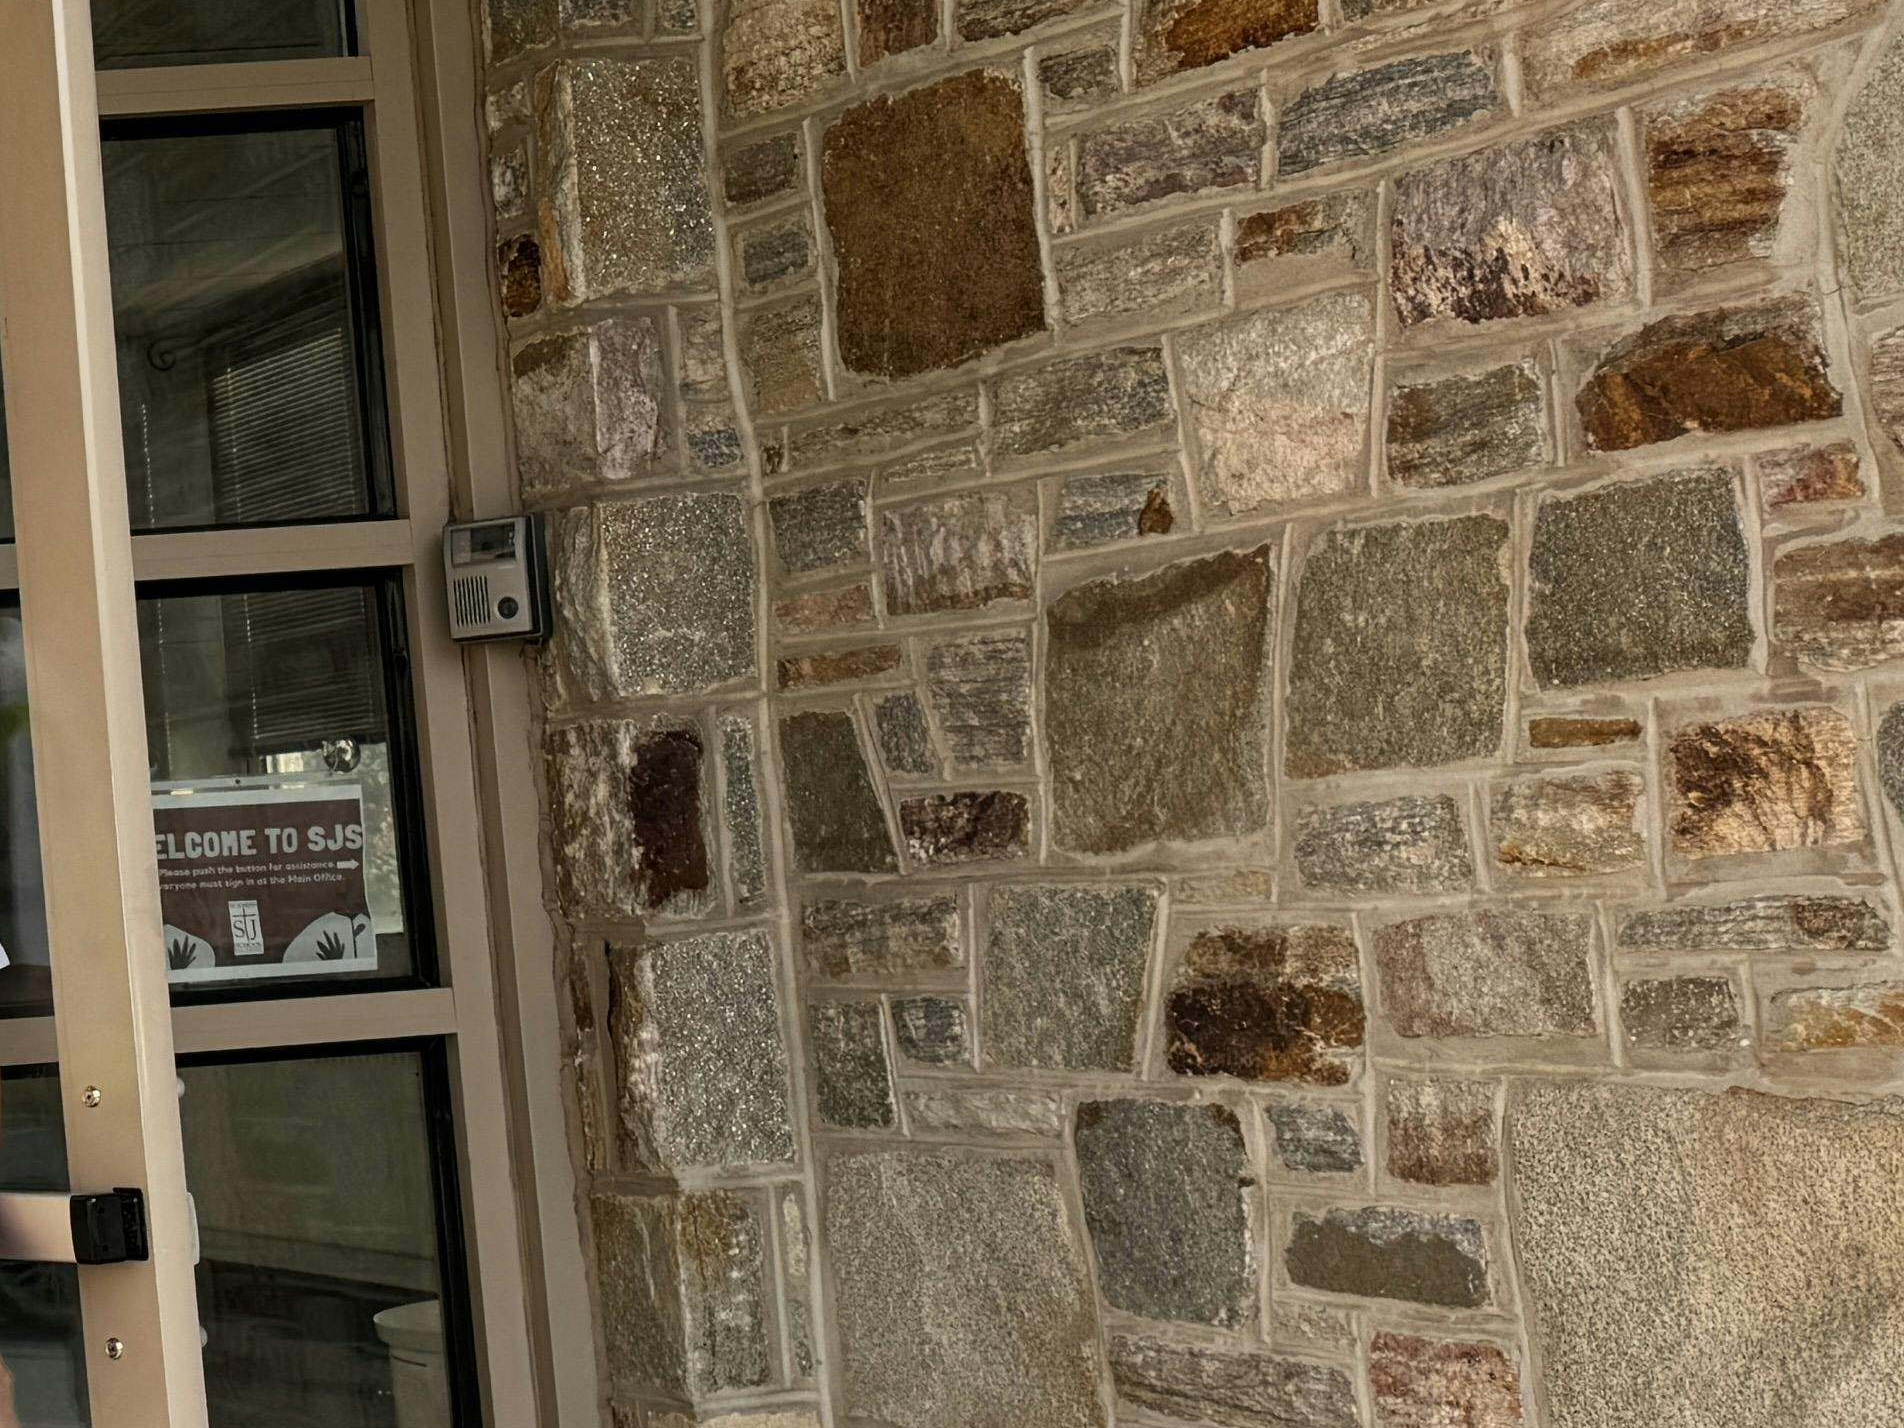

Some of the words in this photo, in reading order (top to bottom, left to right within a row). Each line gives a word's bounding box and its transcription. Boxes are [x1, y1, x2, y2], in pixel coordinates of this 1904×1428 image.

[156, 830, 257, 860] ELCOME
[264, 827, 299, 854] TO
[306, 824, 363, 852] SJS
[192, 866, 216, 877] push
[217, 865, 233, 875] the
[235, 863, 267, 874] button
[269, 862, 283, 871] for
[199, 880, 223, 889] must
[225, 877, 244, 889] sign
[269, 875, 286, 885] the
[288, 874, 312, 884] Main
